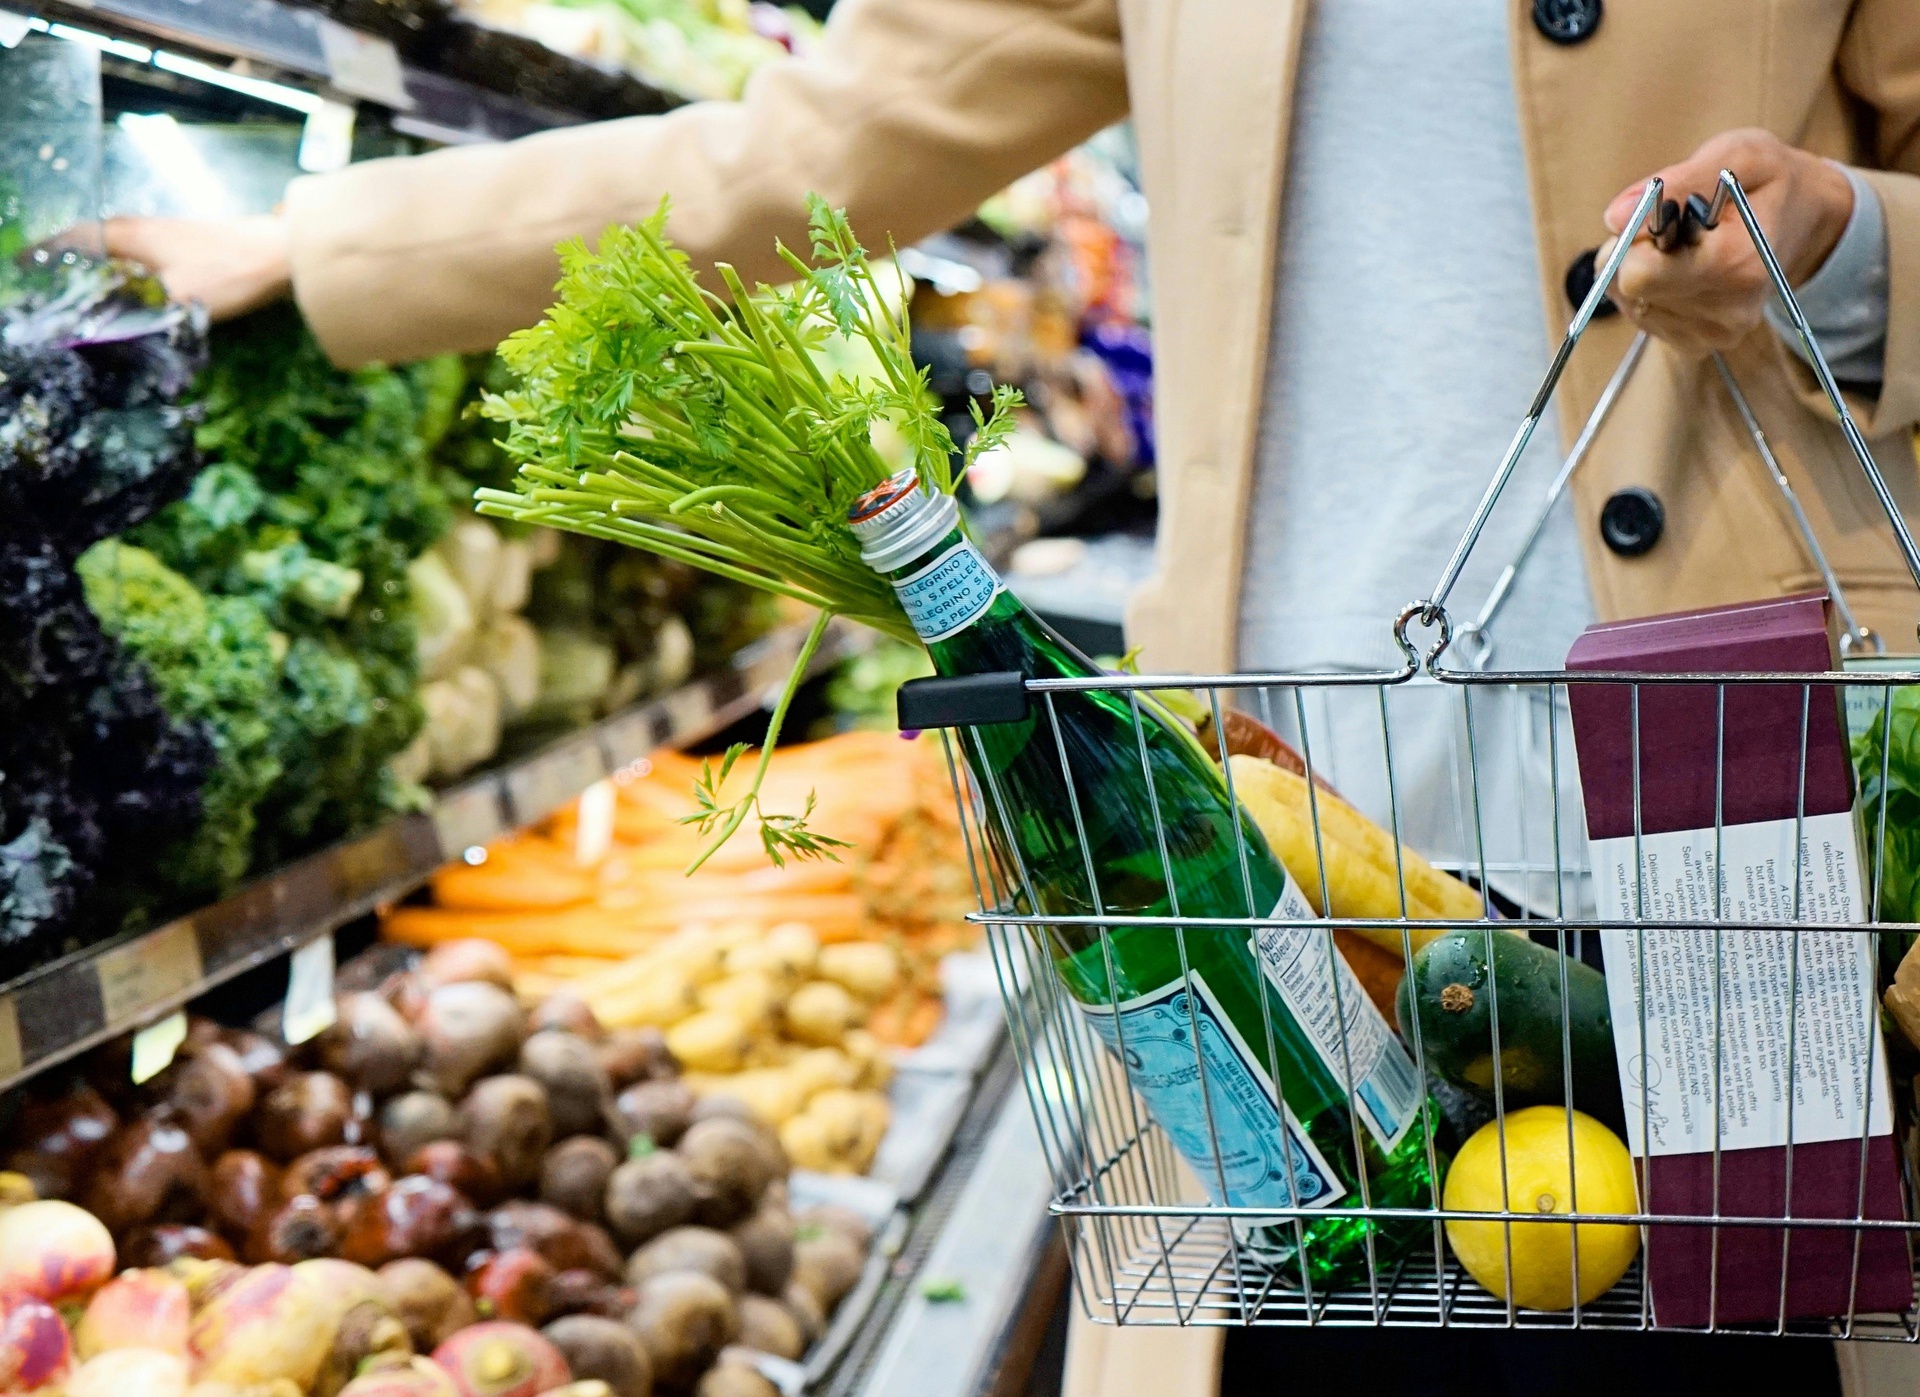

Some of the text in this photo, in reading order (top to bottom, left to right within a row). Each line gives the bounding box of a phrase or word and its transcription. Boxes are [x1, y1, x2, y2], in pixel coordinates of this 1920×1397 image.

[901, 560, 959, 597] ELLEGRINO
[911, 588, 970, 621] ELLEGRINO
[1682, 846, 1692, 866] Seul
[1705, 850, 1713, 862] de
[1823, 841, 1835, 881] delicious
[1835, 849, 1843, 859] At
[1617, 863, 1625, 885] vous
[1648, 853, 1661, 895] Délicieux
[1685, 869, 1692, 881] un
[1695, 859, 1703, 881] avec
[1745, 865, 1756, 899] cheese
[1756, 866, 1764, 879] but
[1766, 859, 1776, 884] these
[1835, 863, 1847, 893] Lesley
[1620, 887, 1627, 899] ne
[1686, 883, 1698, 916] produit
[1756, 883, 1768, 907] really
[1806, 880, 1814, 895] her
[1638, 872, 1654, 935] accompags
[1654, 898, 1661, 910] au
[1701, 909, 1708, 920] en
[1722, 897, 1732, 924] Stow
[1738, 900, 1748, 925] snac
[1749, 902, 1756, 912] or
[1767, 887, 1780, 918] unique
[1808, 898, 1817, 921] team
[1620, 902, 1632, 937] pouz
[1654, 913, 1668, 946] nurel,
[1762, 910, 1771, 934] she
[1831, 910, 1842, 939] The
[1649, 938, 1657, 950] de
[1681, 930, 1694, 963] pouvait
[1702, 924, 1714, 954] etites
[1749, 915, 1763, 958] apasto.
[1774, 921, 1786, 960] ackers
[1266, 937, 1292, 965] Valeur
[1626, 940, 1637, 959] plus
[1765, 937, 1775, 962] when
[1802, 938, 1813, 971] scratch
[1815, 950, 1823, 965] the
[1824, 940, 1833, 958] with
[1695, 955, 1708, 991] fabriqué
[1729, 951, 1740, 979] Foods
[1757, 961, 1766, 976] We
[1827, 961, 1835, 981] care
[1835, 942, 1847, 981] fabulous
[1848, 952, 1858, 980] Foods
[1687, 965, 1699, 1006] satisfaire
[1767, 965, 1779, 996] topped
[1805, 973, 1816, 998] using
[1815, 967, 1826, 987] only
[1830, 984, 1838, 992] in
[1662, 968, 1677, 1015] craquelins
[1664, 892, 1699, 1095] CRAEZ POUR CES FINS CRAQUELINS
[1721, 972, 1733, 1009] fabuleux
[1733, 982, 1744, 1009] adore
[1818, 989, 1827, 1008] way
[1839, 983, 1851, 1011] crisps
[1852, 983, 1859, 996] we
[1657, 1002, 1666, 1013] de
[1702, 994, 1710, 1016] avec
[1750, 1004, 1759, 1020] you
[1762, 997, 1774, 1036] addicted
[1773, 999, 1782, 1017] with
[1822, 1010, 1830, 1018] to
[1831, 995, 1841, 1020] small
[1854, 999, 1863, 1018] love
[1658, 1016, 1671, 1053] fromage
[1670, 1018, 1680, 1038] sont
[1692, 1010, 1704, 1038] Lesley
[1706, 1018, 1714, 1035] des
[1725, 1012, 1739, 1059] craquelins
[1736, 1012, 1749, 1052] fabriquer
[1754, 1023, 1763, 1036] will
[1774, 1020, 1784, 1040] your
[1812, 1019, 1822, 1043] finest
[1824, 1021, 1834, 1046] make
[1845, 1013, 1854, 1034] from
[1698, 1042, 1705, 1050] et
[1756, 1040, 1765, 1051] be
[1768, 1039, 1775, 1047] to
[1855, 1021, 1868, 1055] making
[1665, 1056, 1672, 1068] ou
[1743, 1055, 1751, 1063] et
[1769, 1050, 1778, 1066] this
[1827, 1058, 1838, 1081] great
[1724, 1074, 1732, 1086] de
[1733, 1062, 1742, 1081] sont
[1745, 1067, 1753, 1088] vous
[1770, 1069, 1781, 1102] yummy
[1795, 1086, 1803, 1105] own
[1853, 1077, 1864, 1110] kitchen
[1734, 1085, 1748, 1127] fabriqués
[1748, 1091, 1757, 1111] offrir
[1830, 1085, 1843, 1119] product
